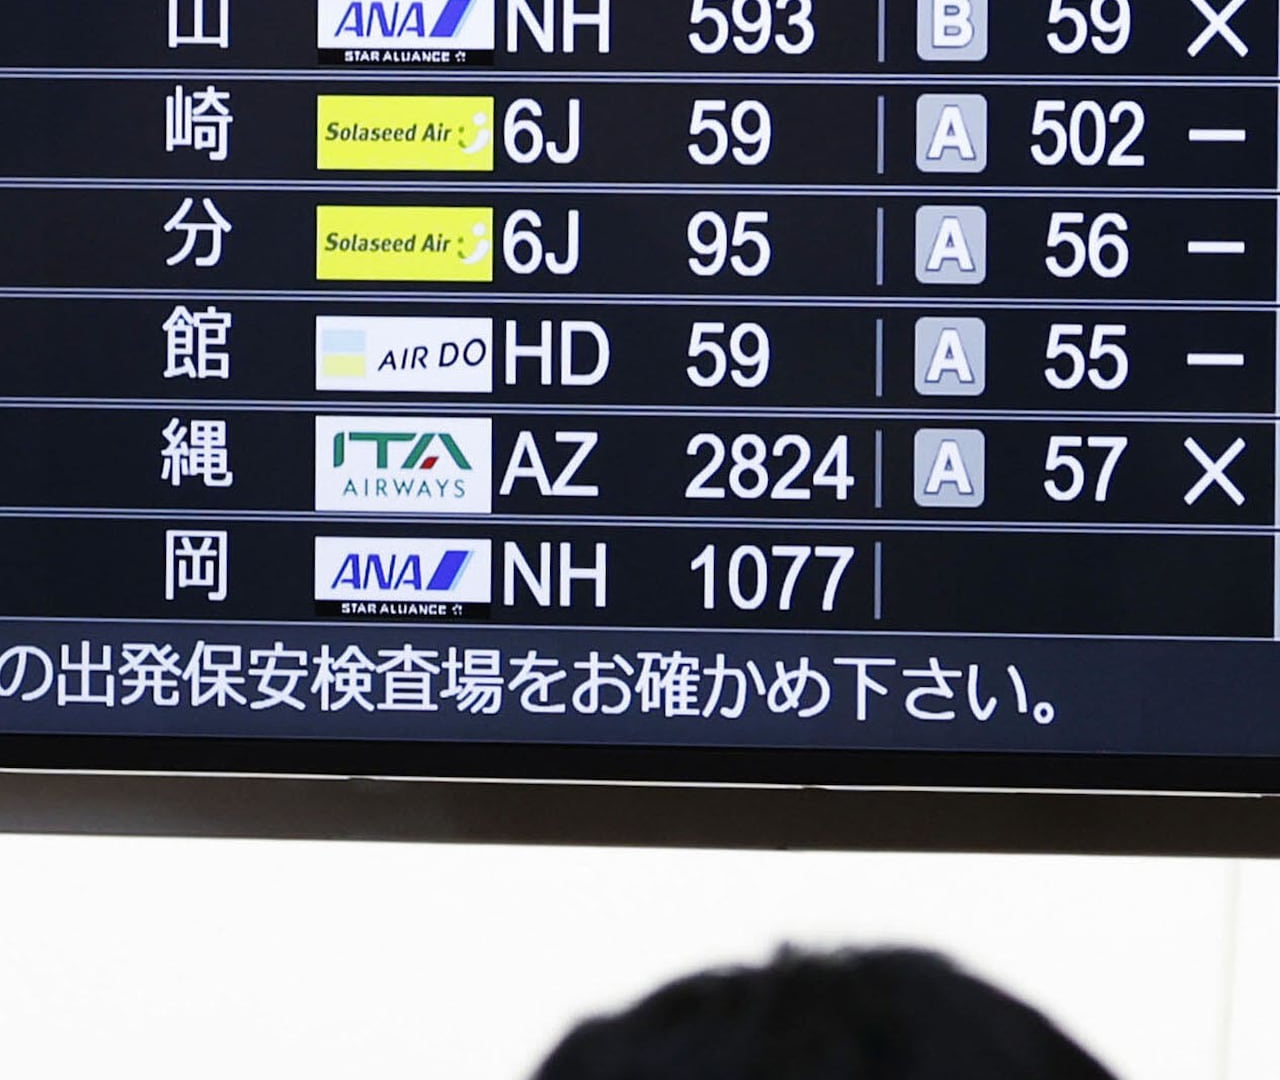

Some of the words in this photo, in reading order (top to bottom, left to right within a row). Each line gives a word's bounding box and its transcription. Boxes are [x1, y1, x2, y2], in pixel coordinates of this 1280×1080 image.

[334, 2, 425, 38] ANA
[324, 122, 416, 142] Solaseed
[420, 122, 452, 142] Air
[503, 99, 580, 163] 6J
[688, 100, 771, 165] 59
[926, 104, 976, 160] A
[1030, 99, 1145, 167] 502
[323, 233, 415, 253] Solaseed
[419, 233, 451, 253] Air
[503, 210, 580, 274] 6J
[688, 211, 770, 276] 95
[926, 216, 975, 272] A
[1045, 211, 1129, 278] 56
[377, 346, 430, 372] AIR
[437, 337, 487, 370] DO
[505, 320, 609, 385] HD
[687, 322, 769, 387] 59
[925, 328, 974, 384] A
[1044, 323, 1129, 390] 55
[342, 478, 466, 498] AIRWAYS
[500, 431, 598, 496] AZ
[685, 434, 854, 499] 2824
[924, 439, 974, 495] A
[1043, 435, 1128, 502] 57
[331, 554, 422, 590] ANA
[503, 542, 607, 607] NH
[691, 545, 854, 610] 1077
